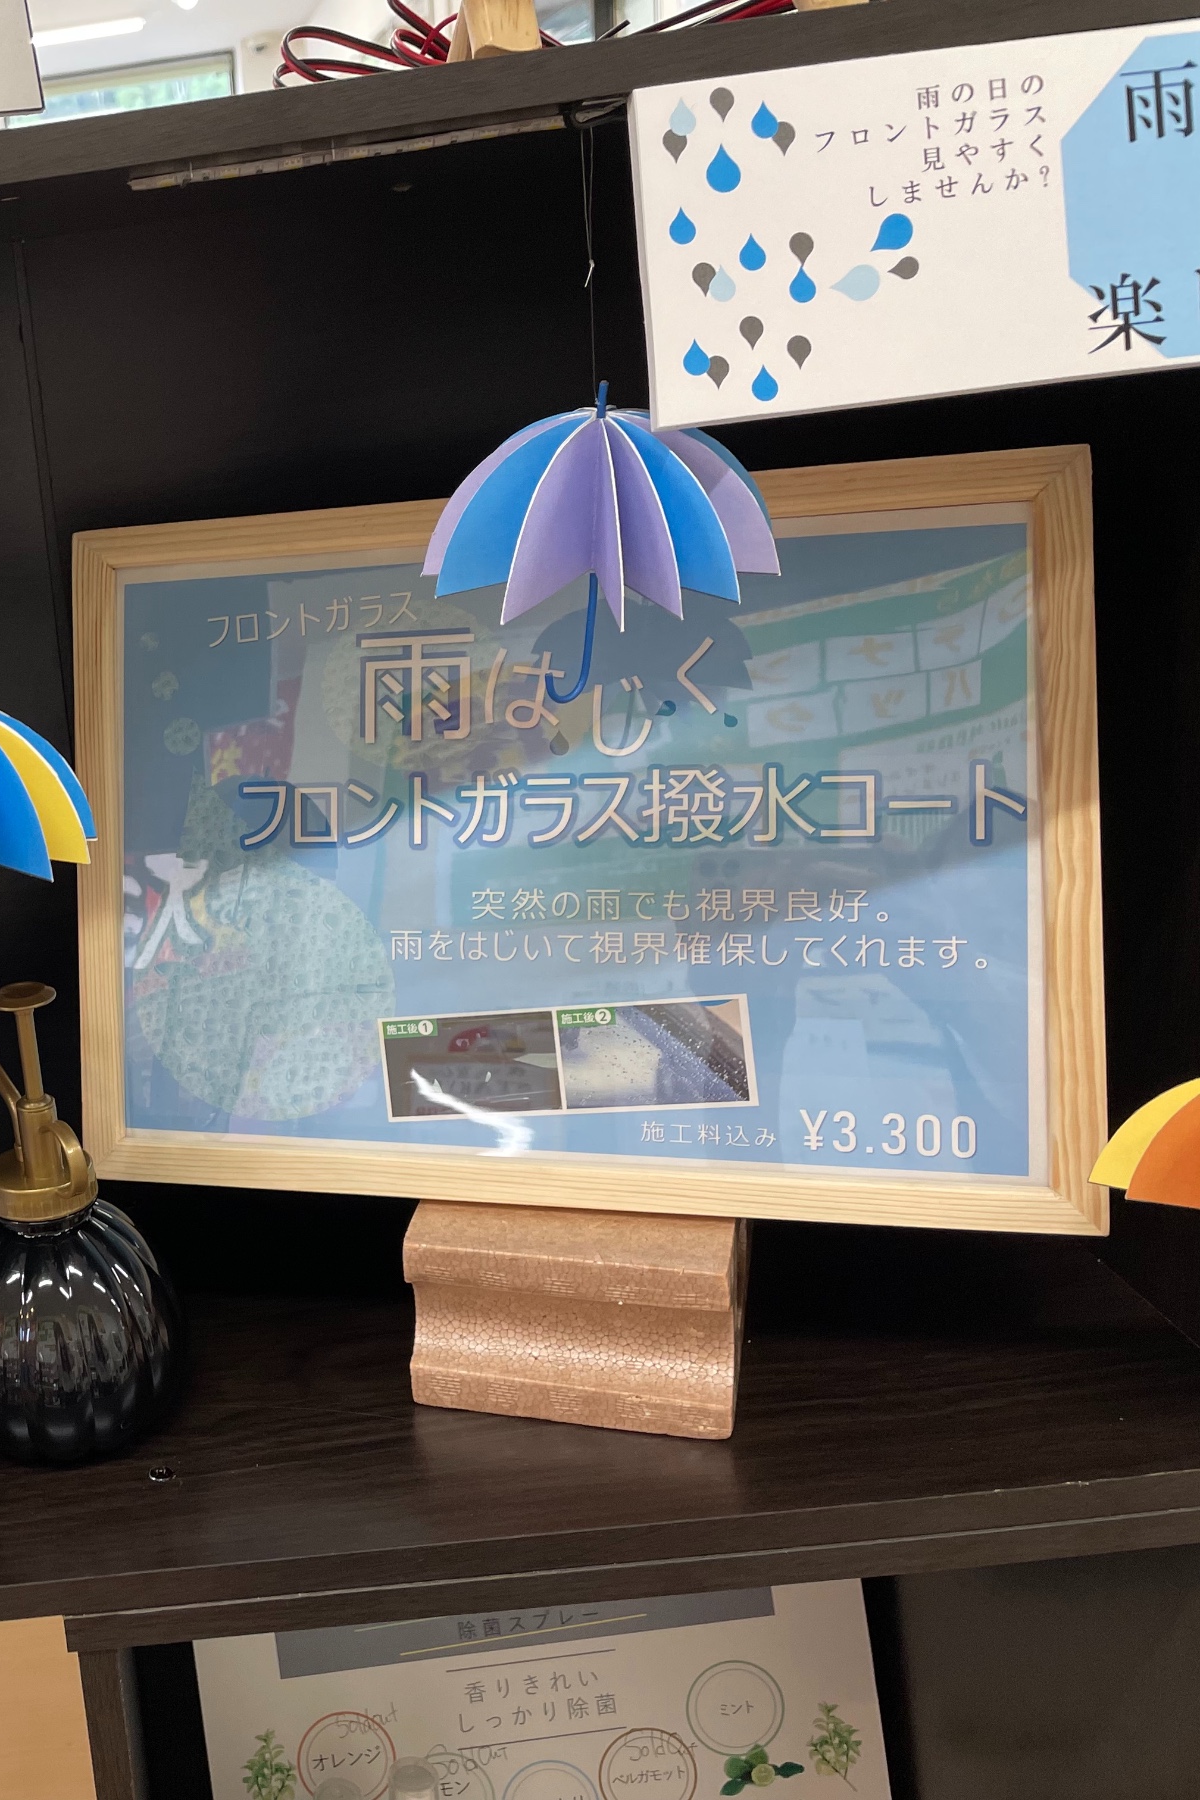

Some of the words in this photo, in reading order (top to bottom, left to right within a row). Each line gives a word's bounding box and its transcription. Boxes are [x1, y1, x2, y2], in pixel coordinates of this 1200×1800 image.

[916, 73, 1045, 111] 雨の日の
[814, 108, 1047, 153] フロントガラス
[921, 135, 1045, 174] 見やすく
[869, 163, 1052, 208] しませんか?
[1088, 272, 1200, 355] 楽
[206, 590, 419, 648] フロントガラス
[356, 627, 719, 758] 雨はじく
[240, 762, 1028, 851] フロントガラス撥水コート
[470, 886, 891, 924] 突然の雨でも視界良好。
[389, 928, 990, 971] 雨をはじいて視界確保してくれます。
[640, 1119, 778, 1150] 施工料込み
[800, 1108, 978, 1160] ¥3.300
[456, 1608, 601, 1642] 除菌スプレー
[463, 1669, 600, 1704] 香りきれい
[456, 1692, 619, 1735] しっかり除菌
[719, 1699, 755, 1717] ミント
[310, 1745, 383, 1774] オレンジ
[611, 1765, 686, 1786] ベルガモット
